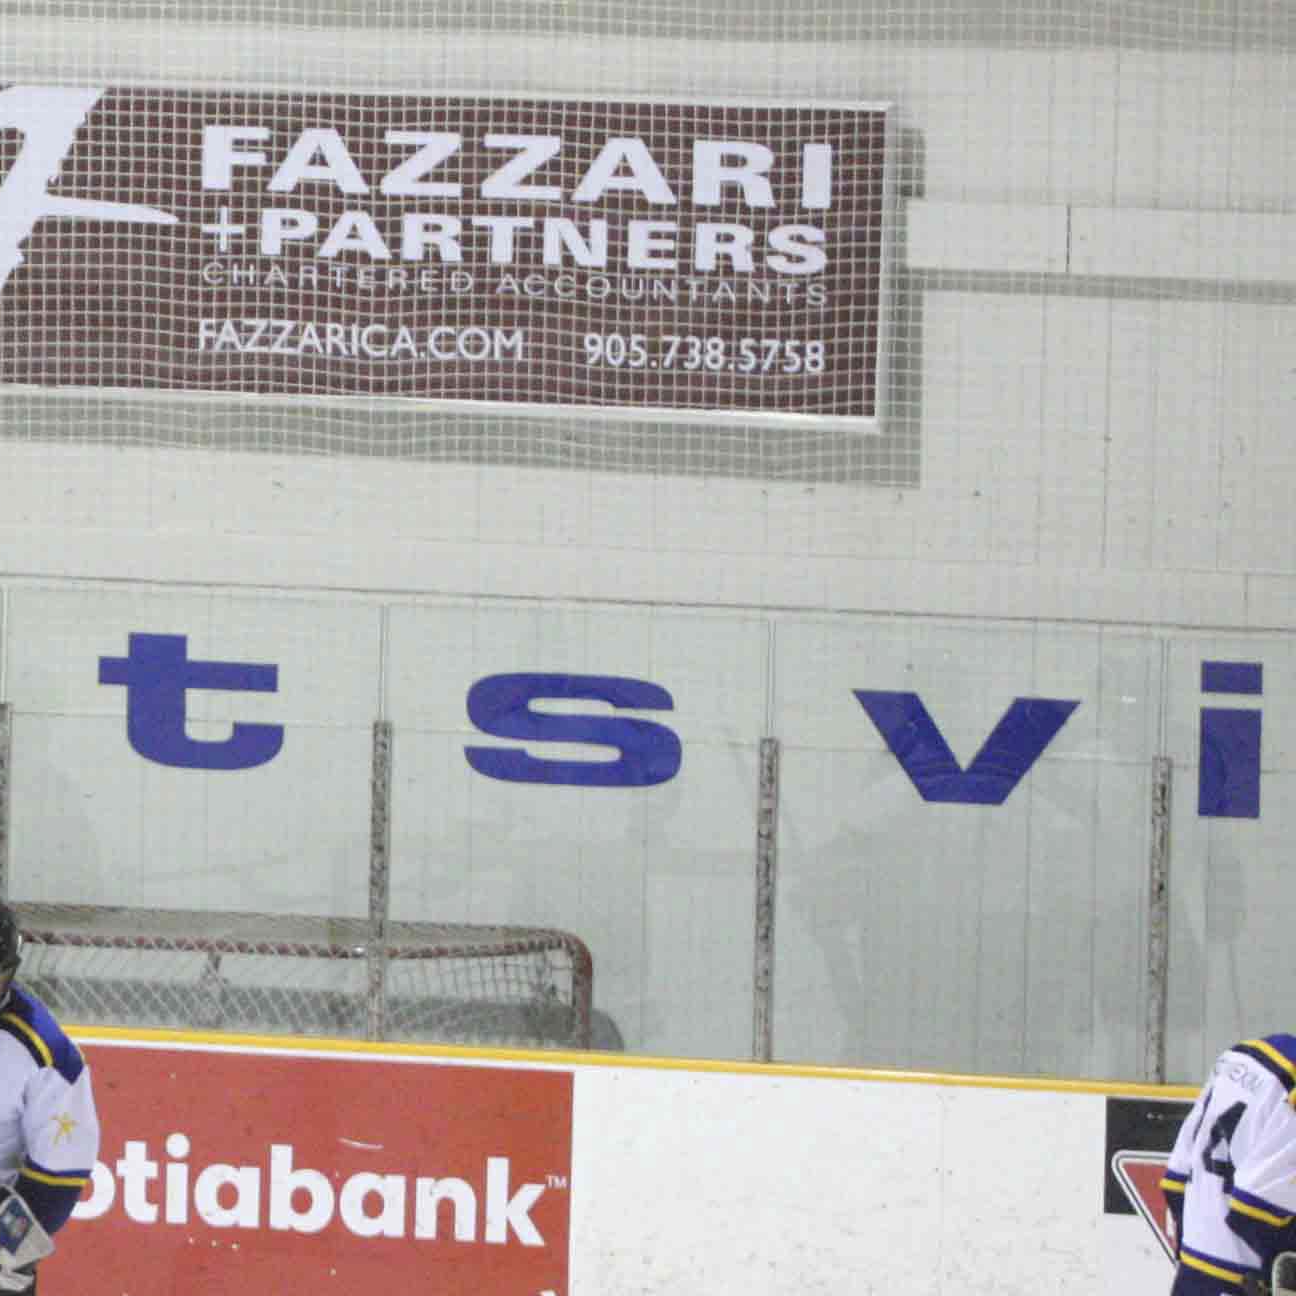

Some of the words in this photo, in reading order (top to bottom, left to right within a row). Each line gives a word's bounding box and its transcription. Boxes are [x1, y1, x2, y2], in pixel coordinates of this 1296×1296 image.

[202, 125, 832, 209] FAZZARI
[203, 262, 474, 292] CHARTERED
[496, 274, 828, 306] ACCOUNTANTS
[198, 318, 524, 361] FAZZARICA.COM
[583, 333, 826, 373] 905.738.5758
[70, 1132, 545, 1248] otiabank
